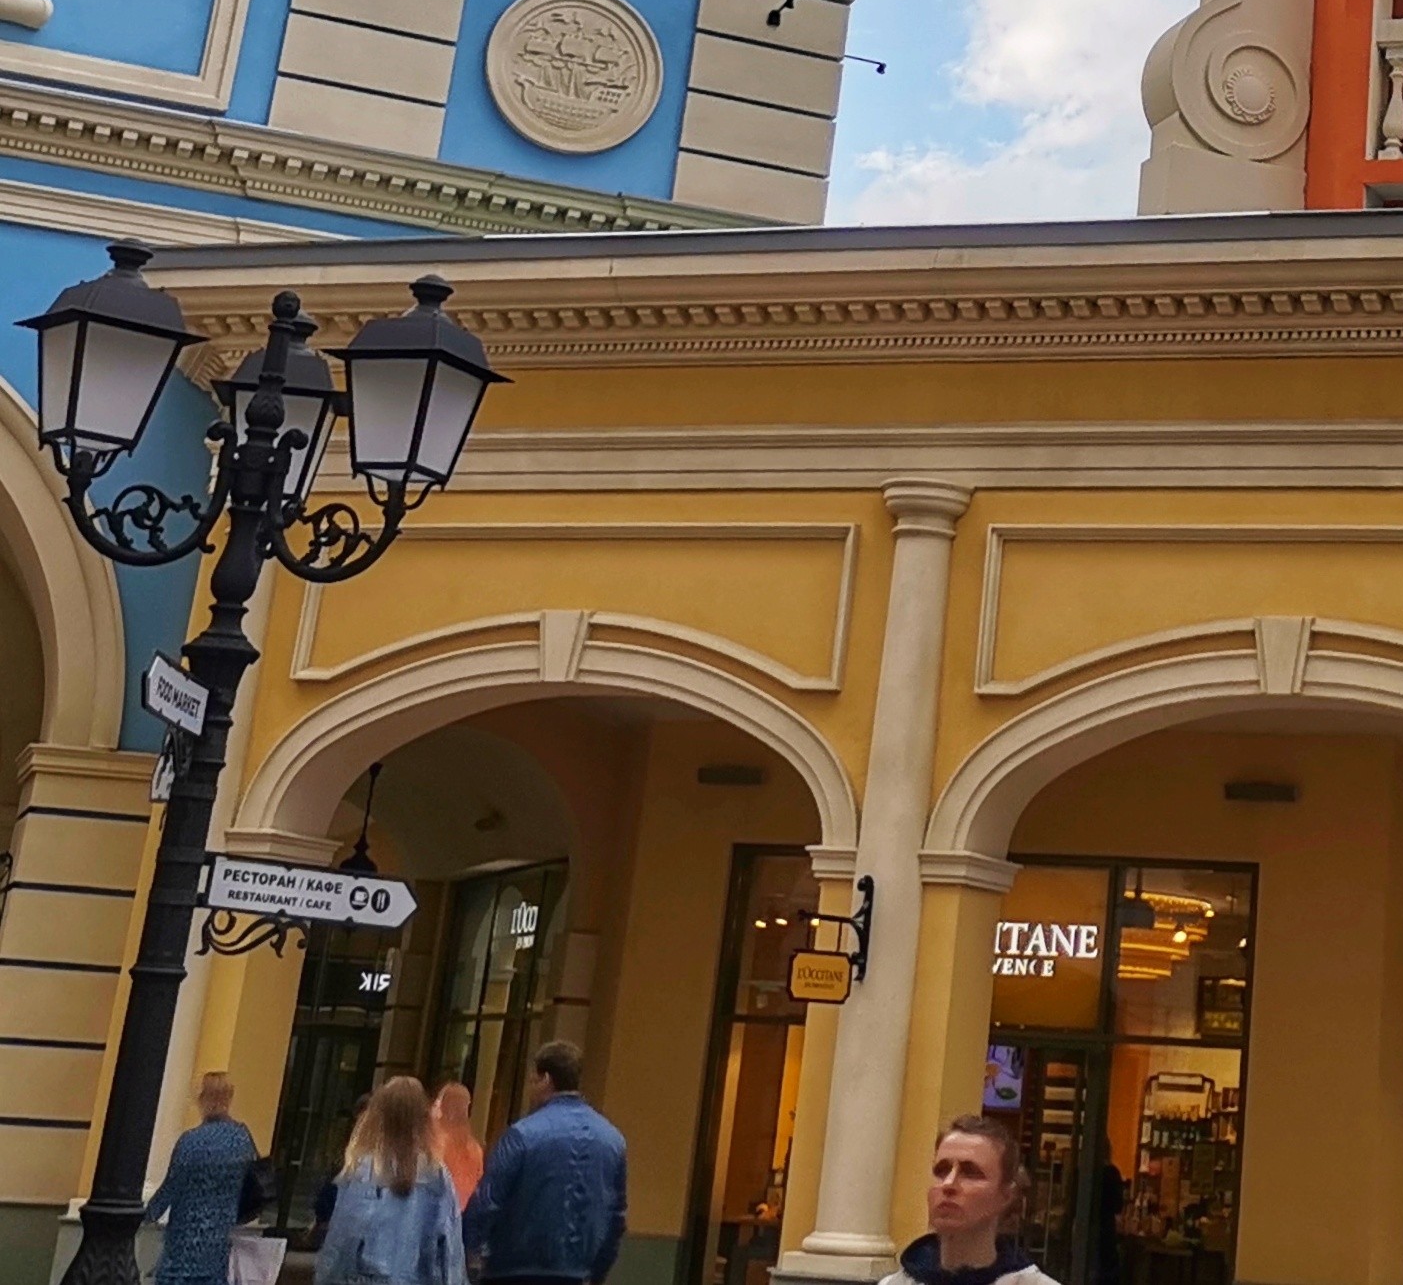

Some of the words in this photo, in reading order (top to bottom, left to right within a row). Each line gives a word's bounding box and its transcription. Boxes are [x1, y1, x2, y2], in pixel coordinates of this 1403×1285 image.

[173, 689, 202, 719] MARKET
[223, 869, 296, 889] РЕСТОРАН
[306, 879, 343, 895] КАФЕ
[228, 889, 298, 907] RESTAURANT
[305, 899, 332, 911] CAFE
